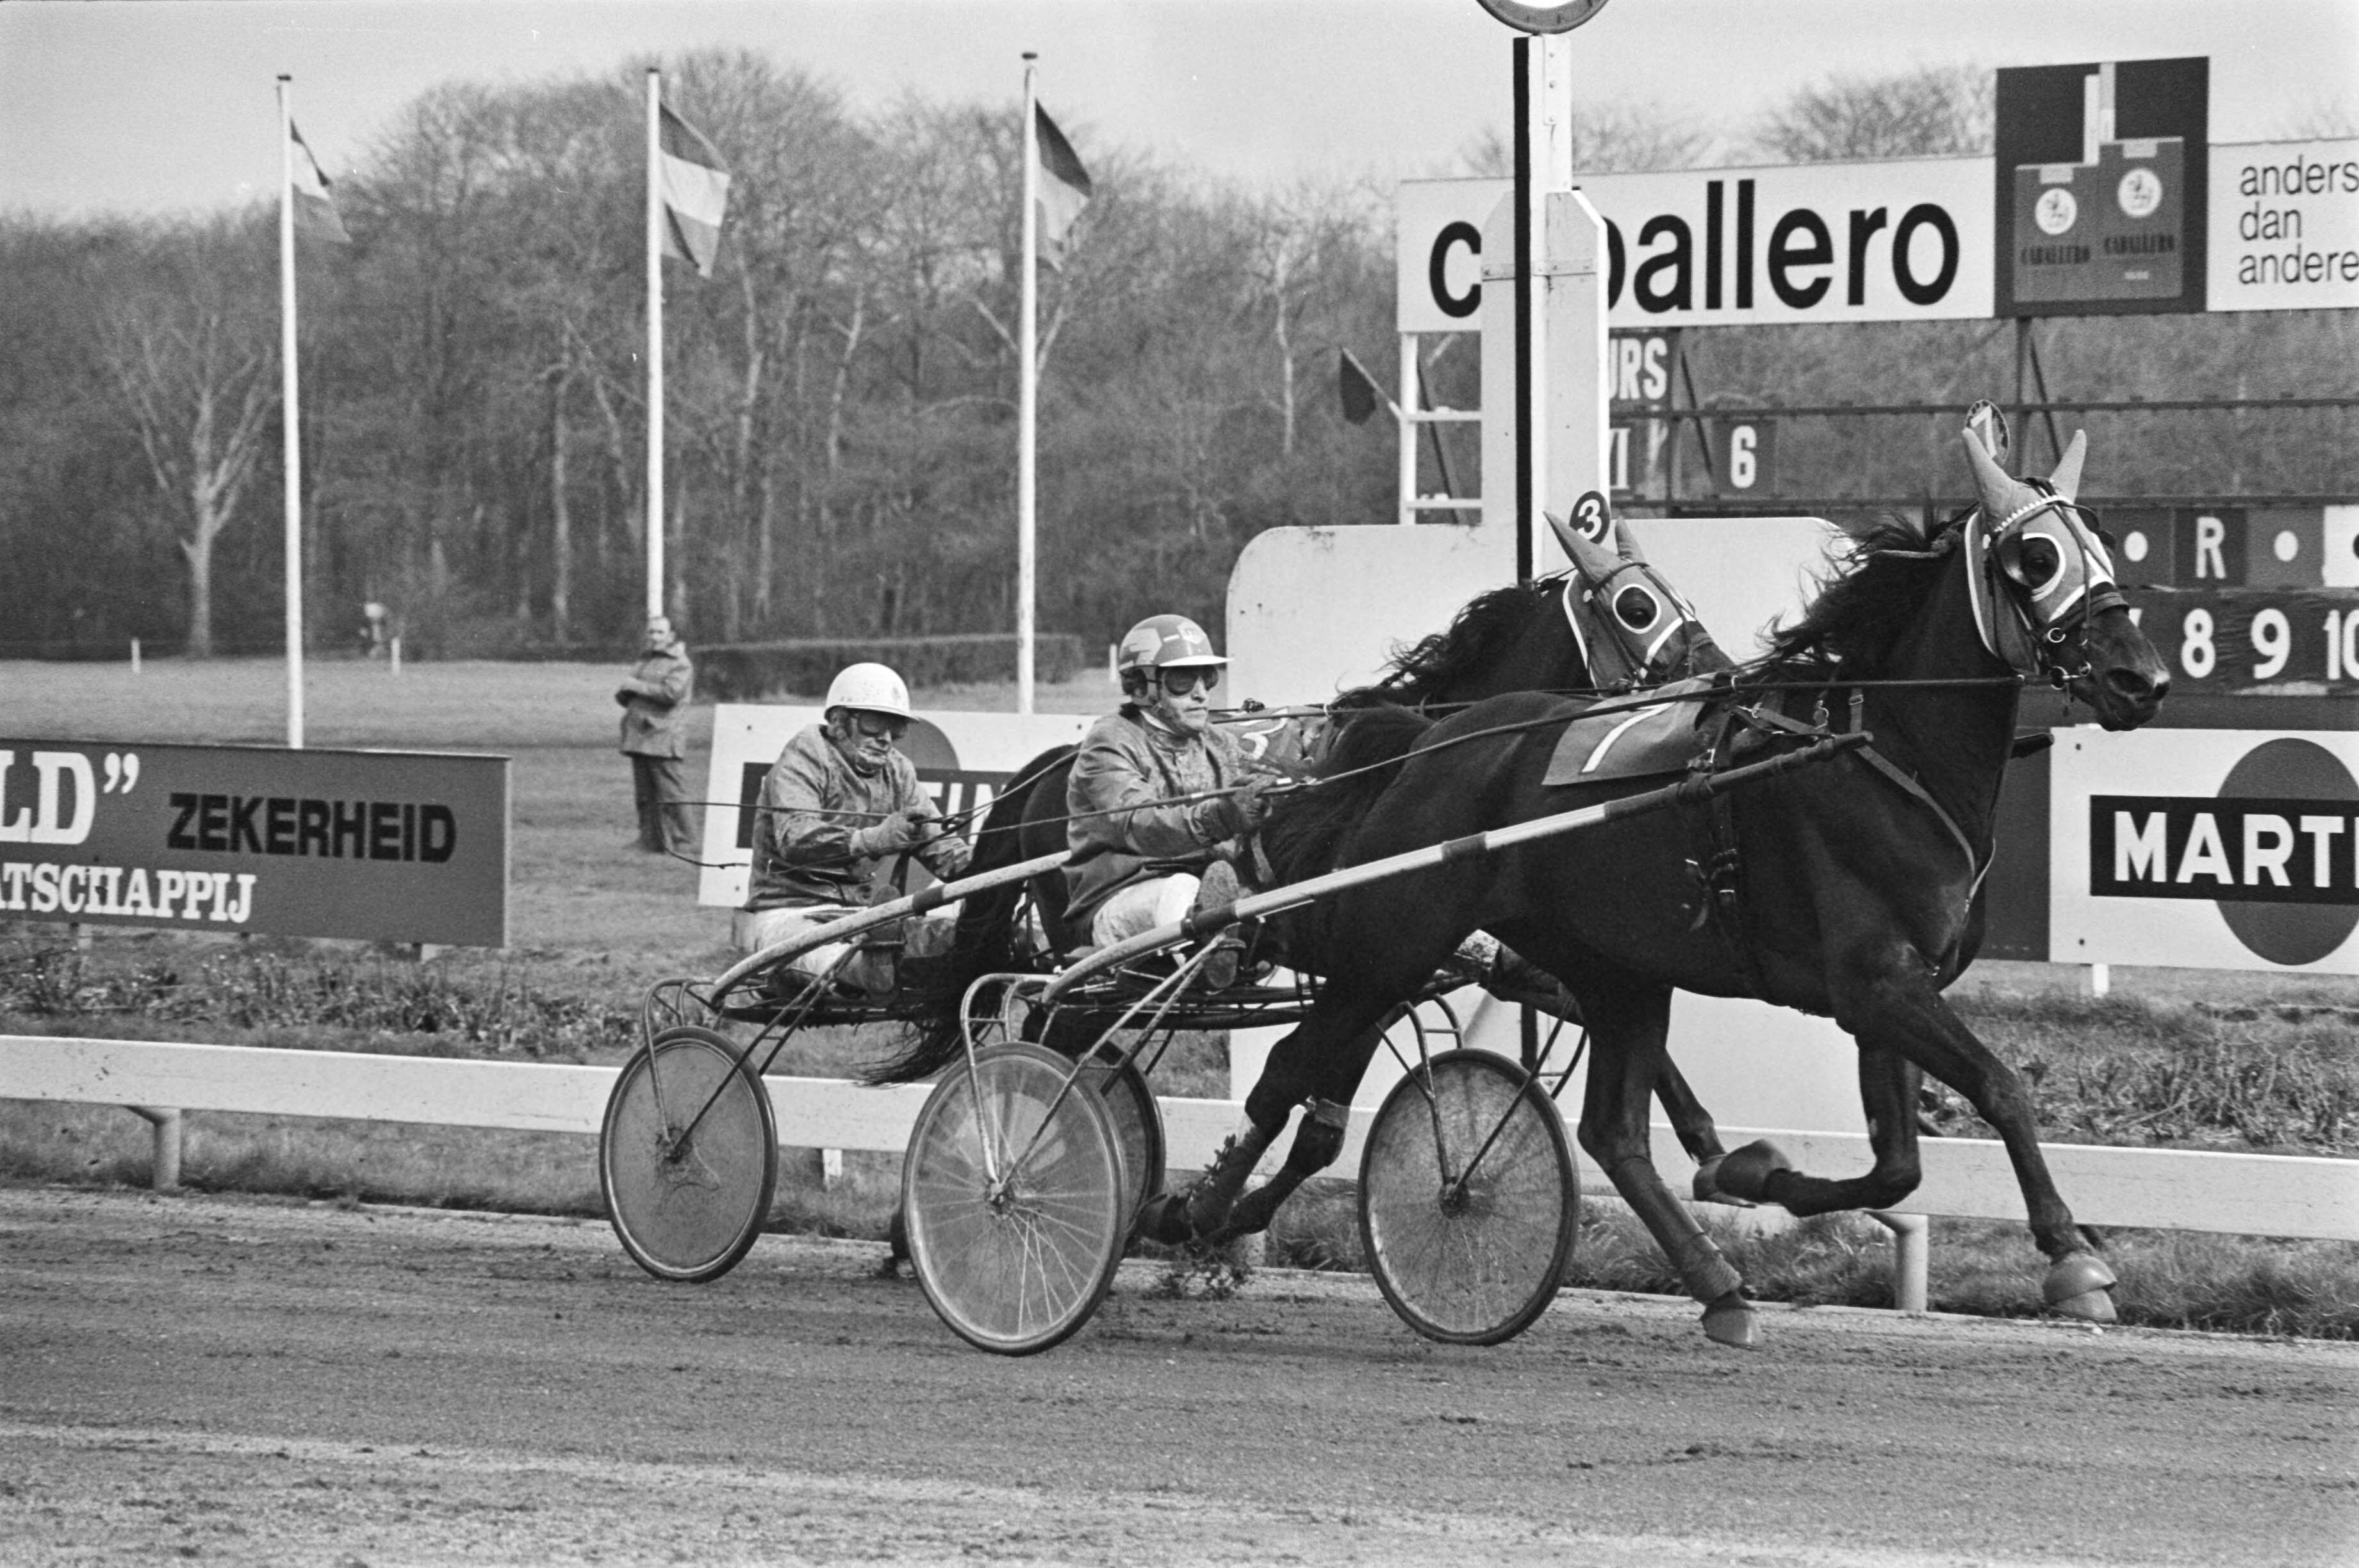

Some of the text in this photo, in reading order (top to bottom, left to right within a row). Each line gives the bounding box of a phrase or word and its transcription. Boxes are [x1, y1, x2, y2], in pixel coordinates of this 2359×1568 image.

[2240, 154, 2359, 197] anders
[1429, 179, 1960, 318] callero
[2240, 201, 2301, 241] dan
[2238, 243, 2359, 284] andere
[1731, 425, 1757, 489] 6
[1577, 499, 1602, 540] 3
[2196, 516, 2226, 579] R
[2181, 608, 2215, 679] 8
[2251, 608, 2291, 680] 9
[1580, 701, 1677, 773] 7
[167, 792, 457, 863] ZEKERHEID
[0, 862, 257, 924] TSCHAPPIJ
